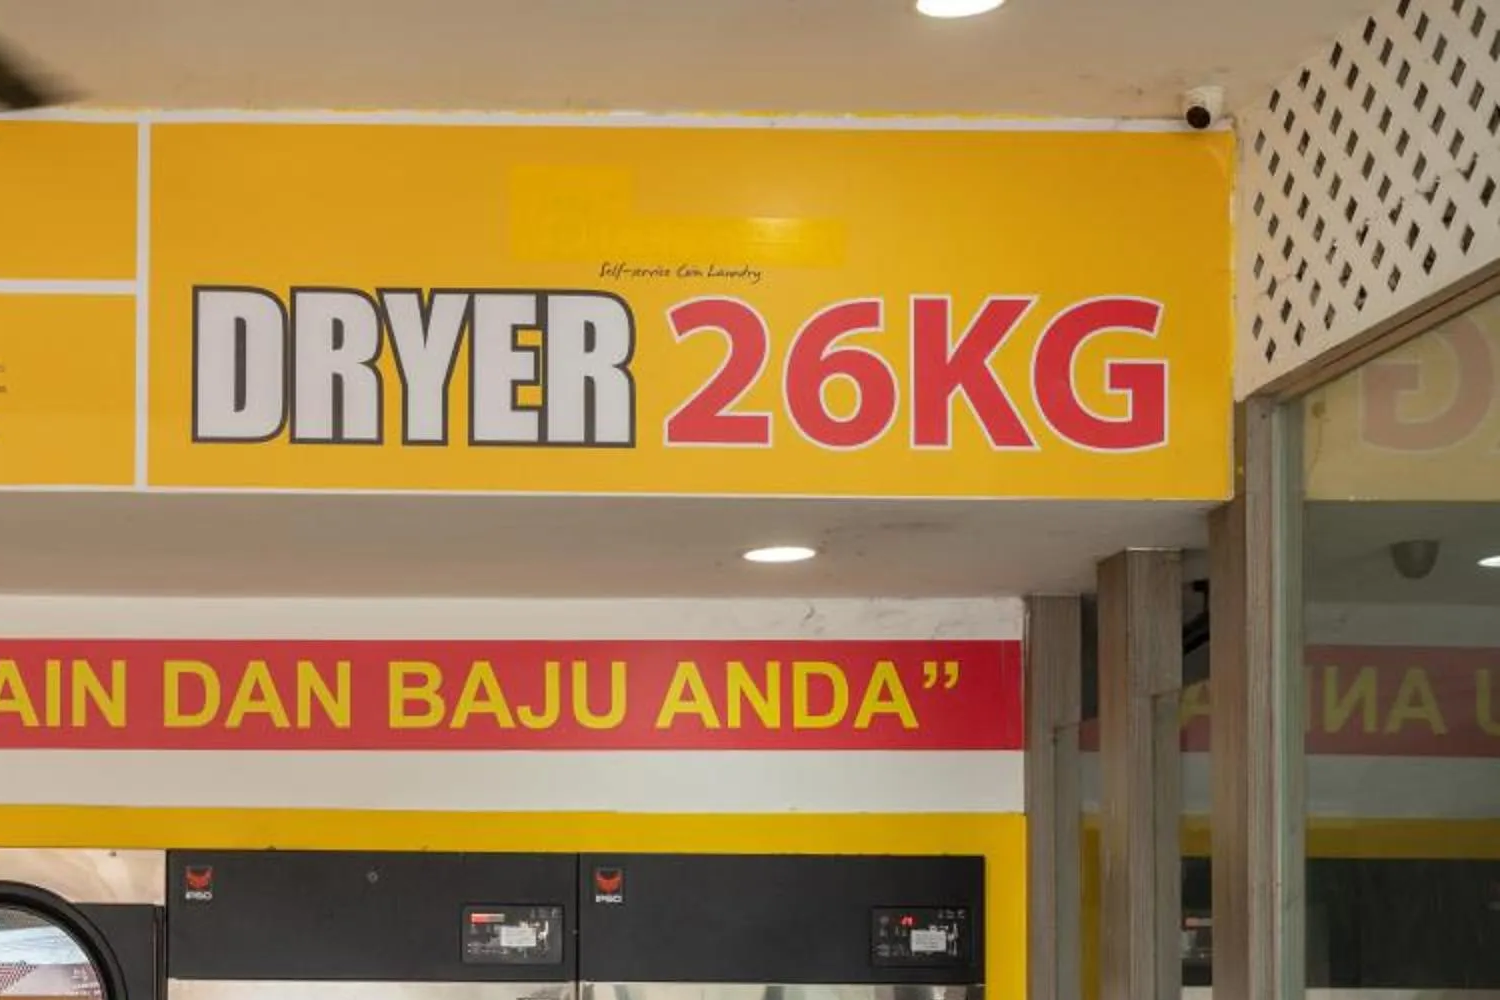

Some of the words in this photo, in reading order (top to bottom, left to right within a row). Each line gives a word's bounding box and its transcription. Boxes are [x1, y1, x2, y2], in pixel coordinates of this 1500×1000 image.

[600, 262, 671, 278] Self-service
[707, 265, 762, 284] Laundry
[191, 286, 637, 449] DRYER
[662, 292, 1170, 454] 26KG
[161, 658, 353, 729] DAN
[387, 660, 629, 731] BAJU
[655, 659, 961, 730] ANDA”
